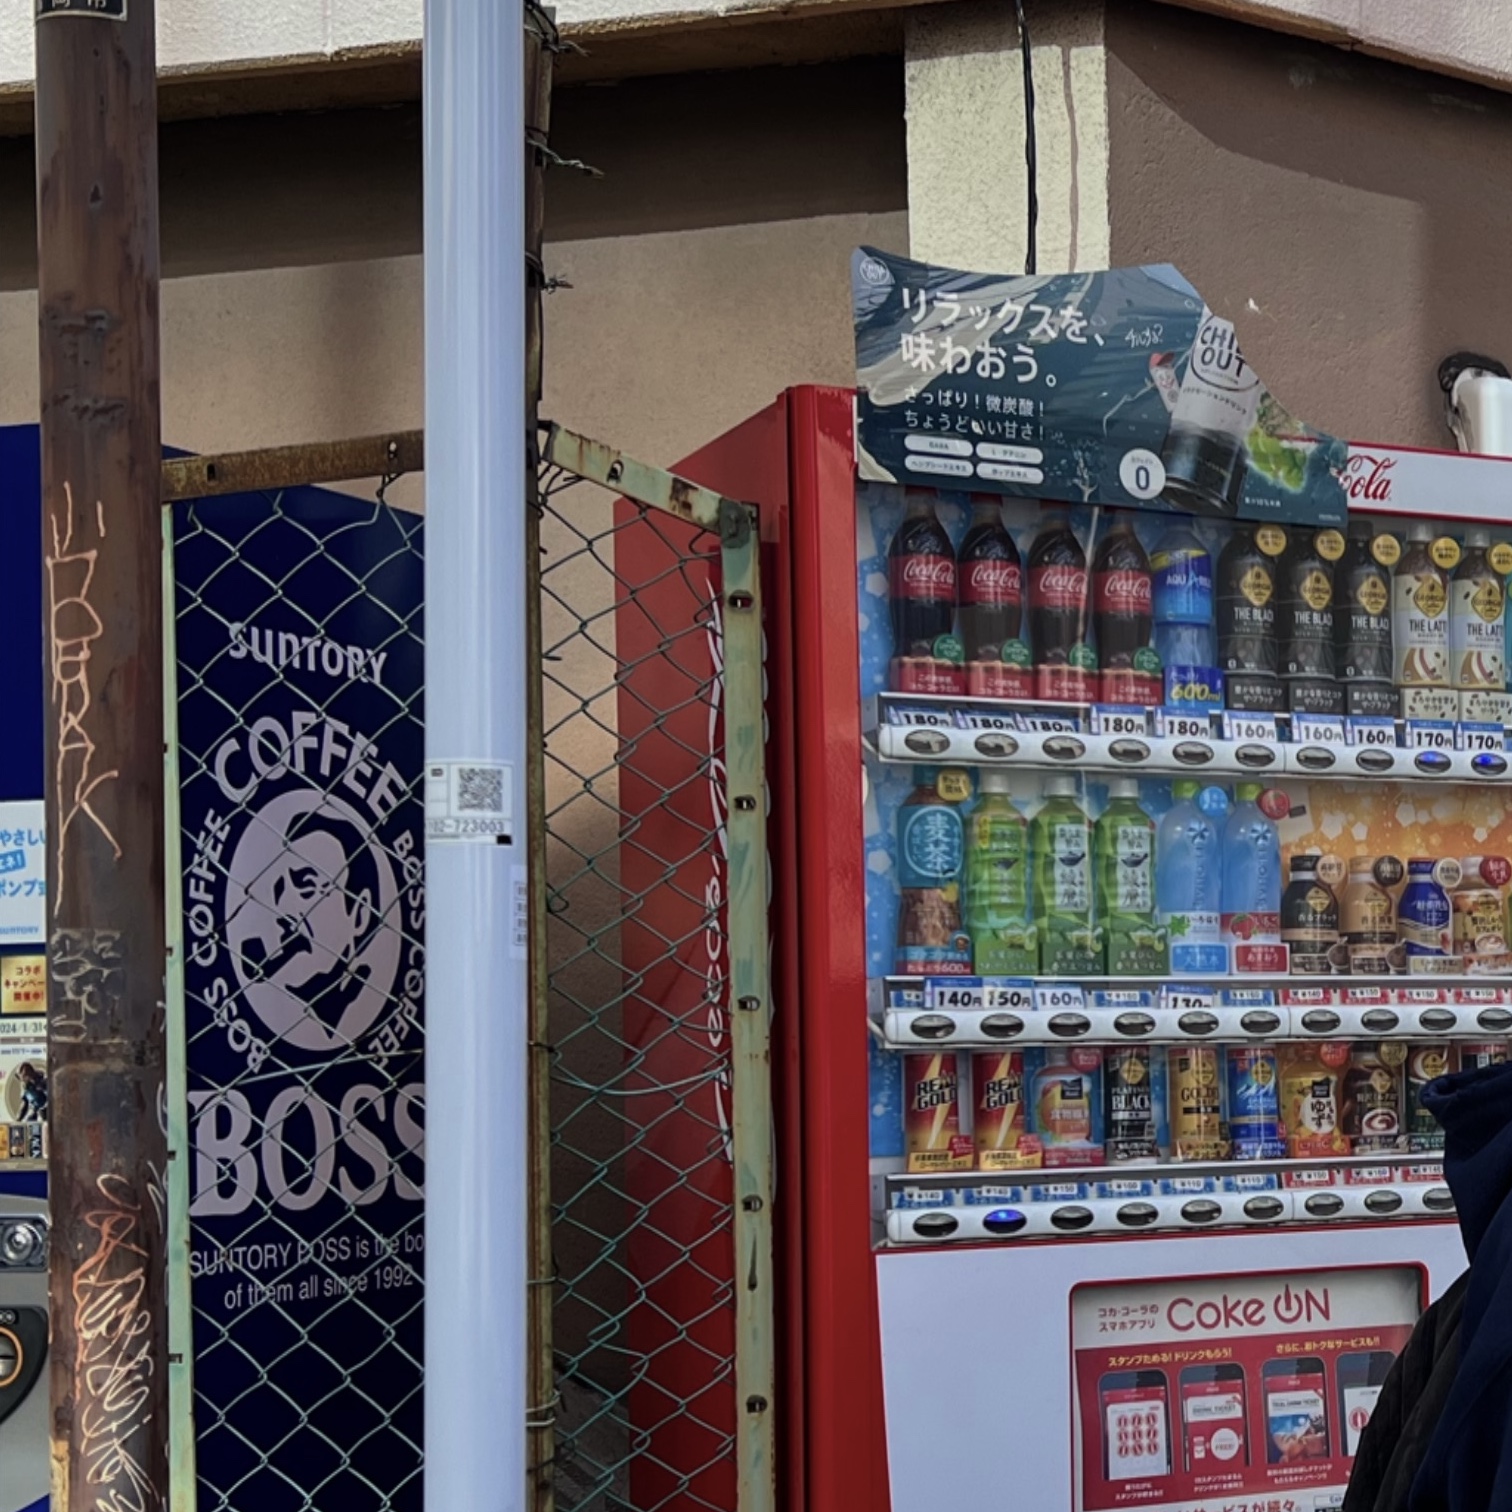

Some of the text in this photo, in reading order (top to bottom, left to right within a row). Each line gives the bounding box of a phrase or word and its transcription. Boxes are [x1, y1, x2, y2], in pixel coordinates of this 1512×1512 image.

[902, 287, 1105, 347] リラックスを、
[901, 333, 1057, 388] 味わおう。
[1200, 347, 1248, 378] OUT
[1134, 465, 1151, 492] 0
[1234, 607, 1250, 621] THE
[1294, 611, 1311, 625] THE
[1351, 615, 1368, 629] THE
[1409, 619, 1425, 632] THE
[1467, 623, 1483, 636] THE
[229, 621, 389, 688] SUNTORY
[1102, 717, 1144, 734] 180円
[1168, 720, 1208, 736] 180円
[1235, 722, 1275, 739] 160円
[1303, 723, 1343, 743] 160円
[1357, 728, 1396, 745] 160円
[1415, 730, 1453, 747] 170円
[1466, 733, 1503, 749] 170円
[213, 709, 410, 826] COFFEE
[188, 808, 231, 967] COFFEE
[938, 991, 982, 1007] 140円
[987, 990, 1031, 1007] 150円
[1039, 992, 1082, 1007] 160円
[189, 1231, 400, 1278] SUNTORY BOSS is the
[224, 1263, 415, 1310] of them all since 1992
[1098, 1303, 1159, 1319] コカ・コーラの
[1166, 1284, 1331, 1332] Coke ON
[1098, 1319, 1156, 1333] スマホアプリ
